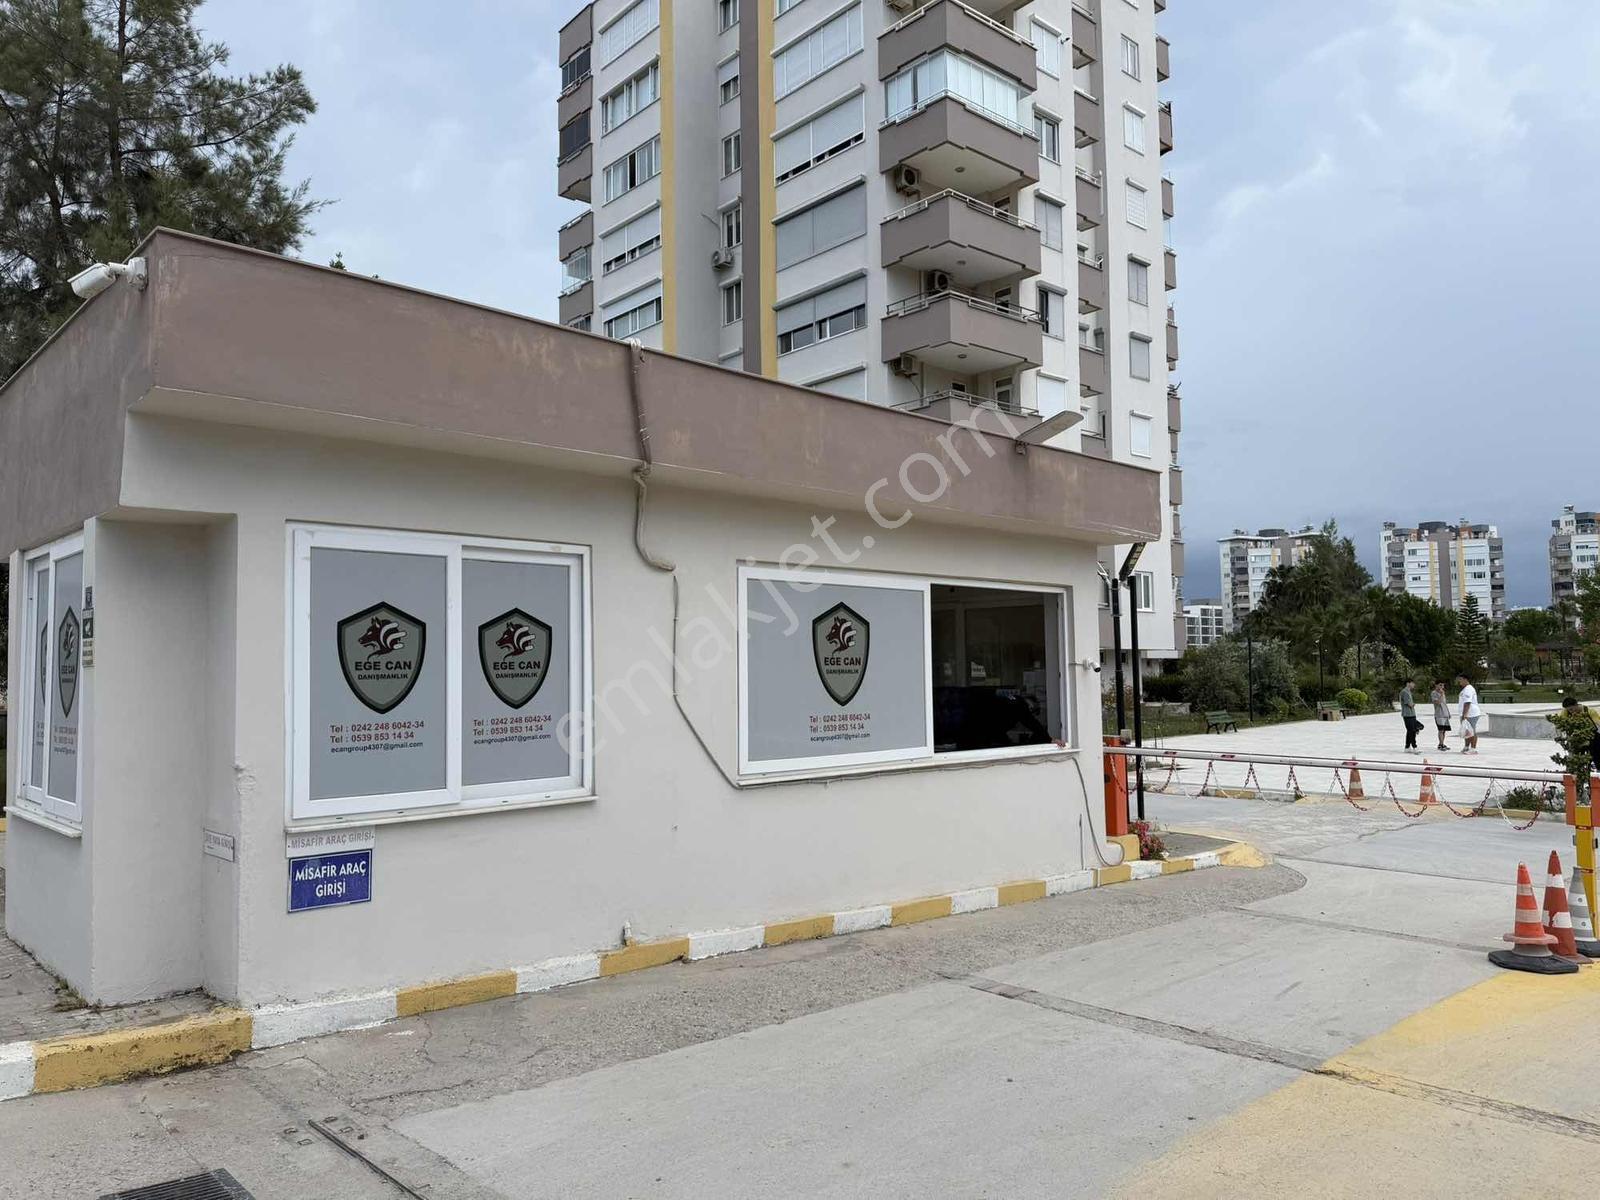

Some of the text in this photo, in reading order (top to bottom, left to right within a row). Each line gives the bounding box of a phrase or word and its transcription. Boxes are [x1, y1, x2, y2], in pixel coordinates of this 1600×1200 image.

[354, 661, 412, 670] EGE CAN
[493, 660, 540, 670] EGE CAN
[824, 657, 862, 666] EGE CAN
[351, 724, 372, 732] 0242
[374, 722, 390, 730] 248
[392, 720, 424, 730] 6042-34
[330, 735, 343, 743] Tel
[351, 734, 372, 742] 0539
[374, 732, 390, 740] 853
[404, 731, 414, 739] 34
[291, 835, 324, 848] MİSAFİR
[325, 834, 346, 844] ARAÇ
[295, 861, 367, 881] MİSAFİR ARAÇ
[316, 878, 346, 898] GİRİŞİ
